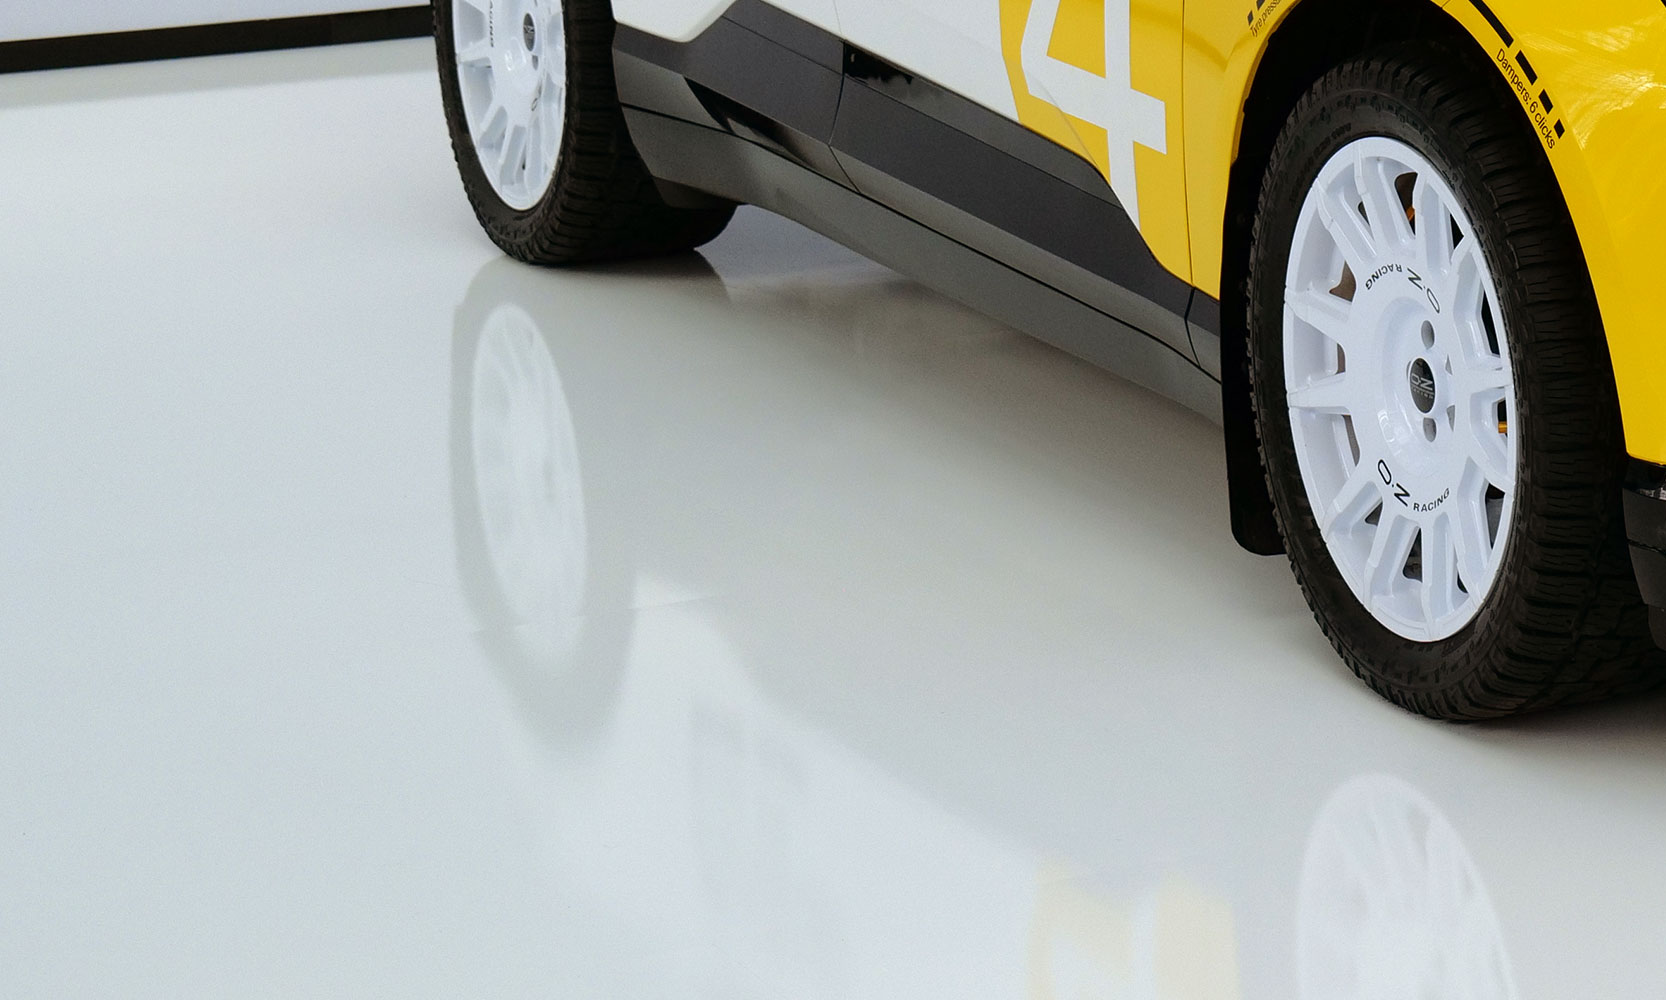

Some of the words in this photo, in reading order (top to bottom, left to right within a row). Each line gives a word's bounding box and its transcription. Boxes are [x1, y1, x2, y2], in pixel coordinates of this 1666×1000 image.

[1496, 48, 1532, 105] Dampers:
[1529, 101, 1539, 114] 6
[1534, 112, 1556, 149] clicks
[1365, 263, 1403, 290] RACING
[1413, 487, 1450, 513] RACING
